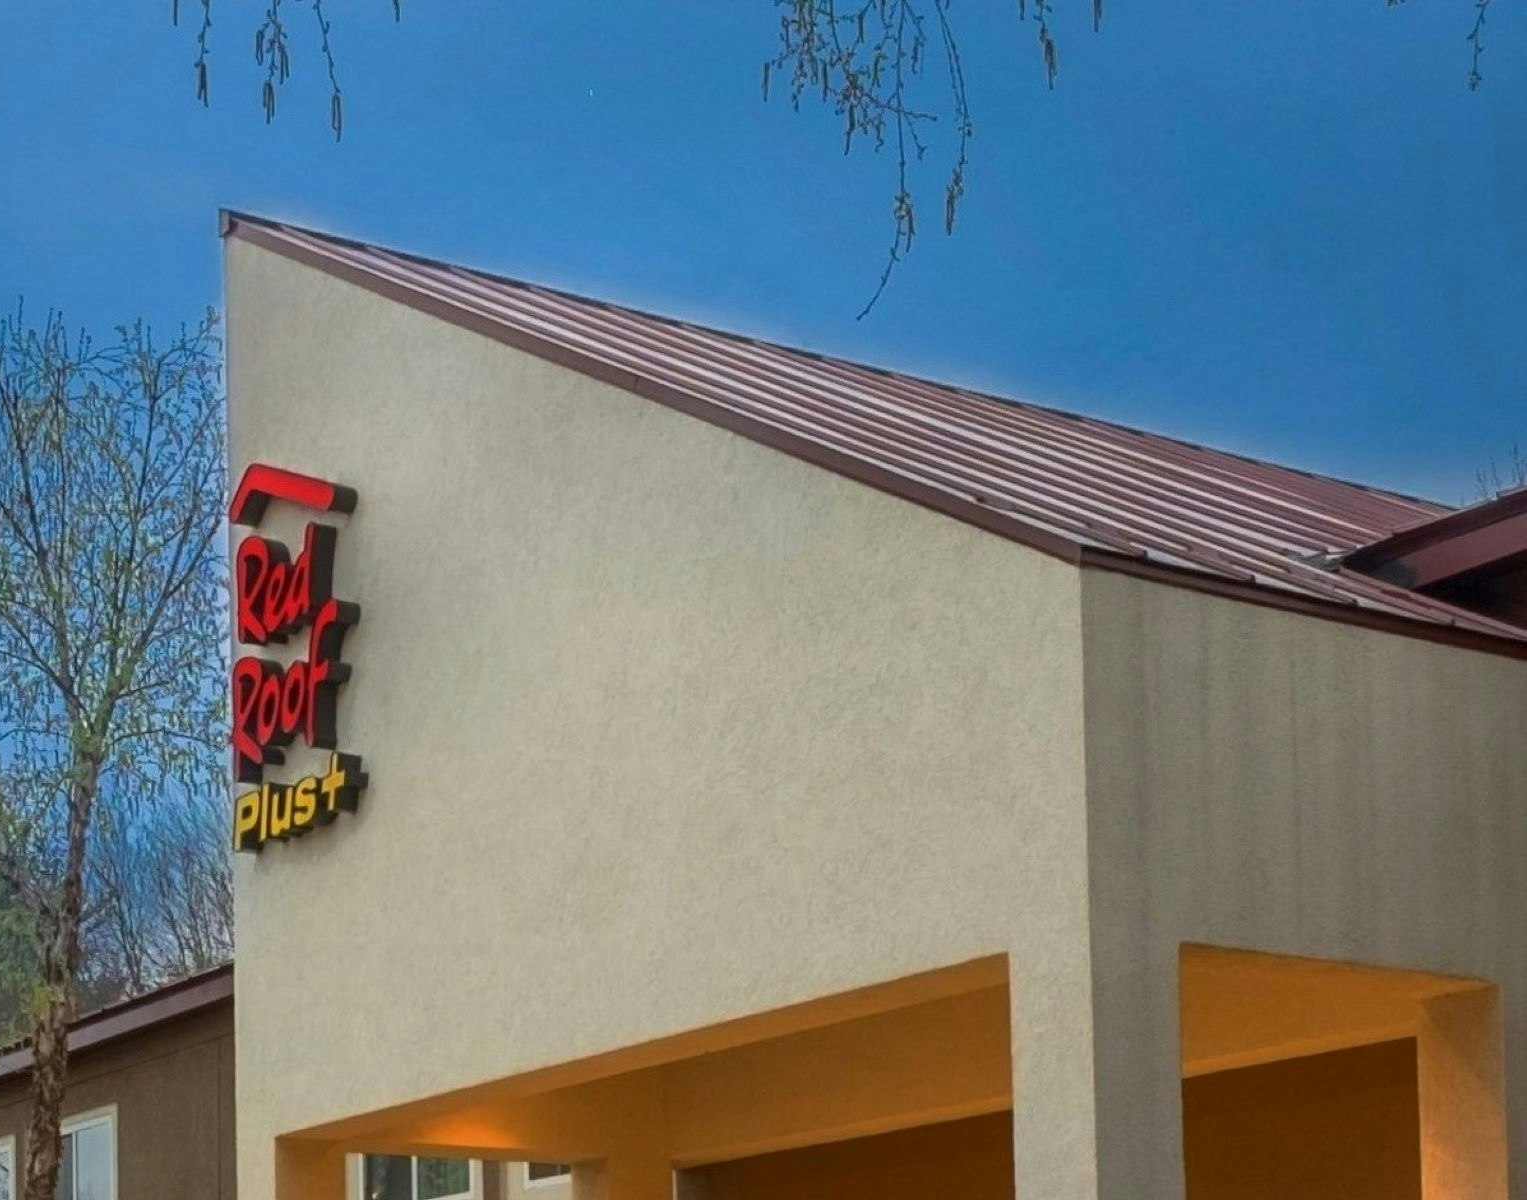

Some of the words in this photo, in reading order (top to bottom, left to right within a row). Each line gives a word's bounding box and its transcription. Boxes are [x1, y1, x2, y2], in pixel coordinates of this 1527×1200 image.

[237, 521, 316, 645] Red
[233, 597, 339, 782] Roof
[233, 751, 347, 852] Plus+
